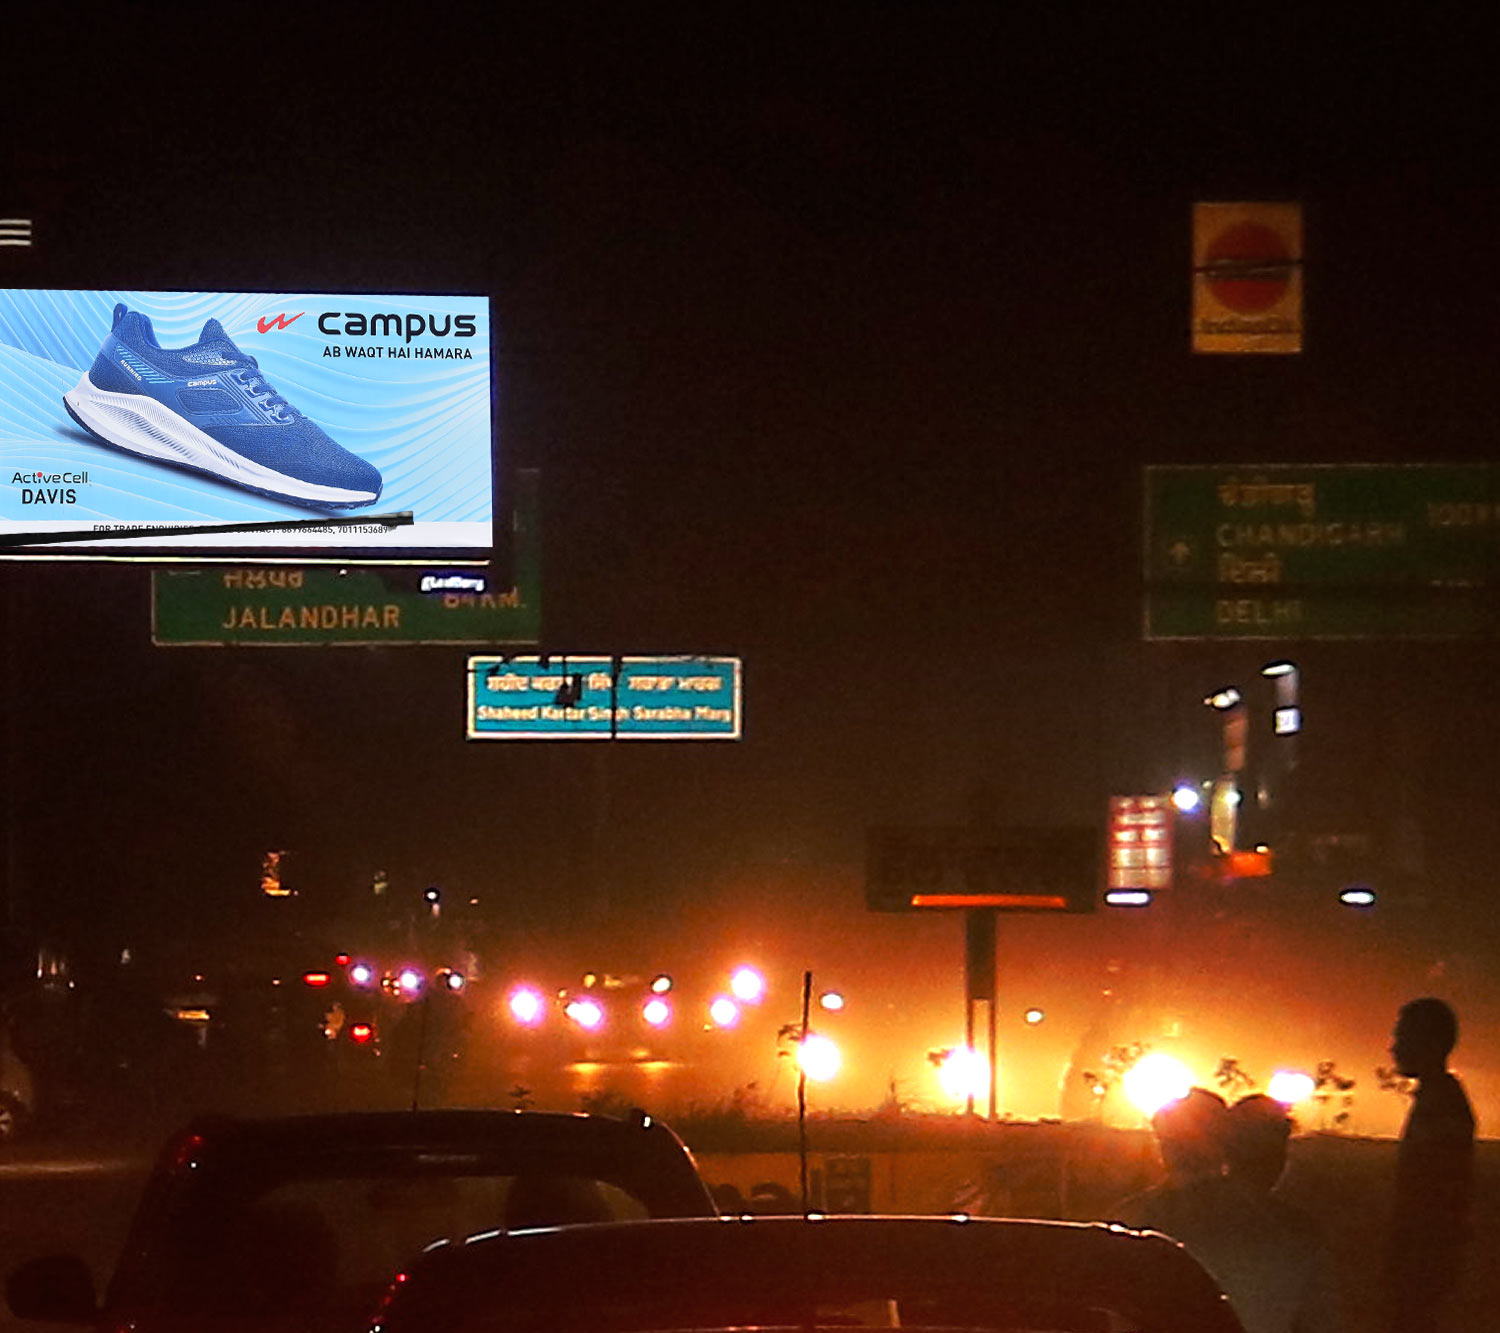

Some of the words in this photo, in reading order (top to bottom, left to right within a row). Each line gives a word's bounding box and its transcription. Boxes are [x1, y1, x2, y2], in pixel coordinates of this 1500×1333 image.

[318, 312, 476, 343] campus
[322, 346, 341, 358] AB
[345, 346, 384, 359] WAQT
[388, 347, 411, 359] HAI
[414, 347, 473, 360] HAMARA
[21, 489, 77, 505] DAVIS
[222, 605, 400, 630] JALANDHAR
[477, 706, 538, 720] Shaheed
